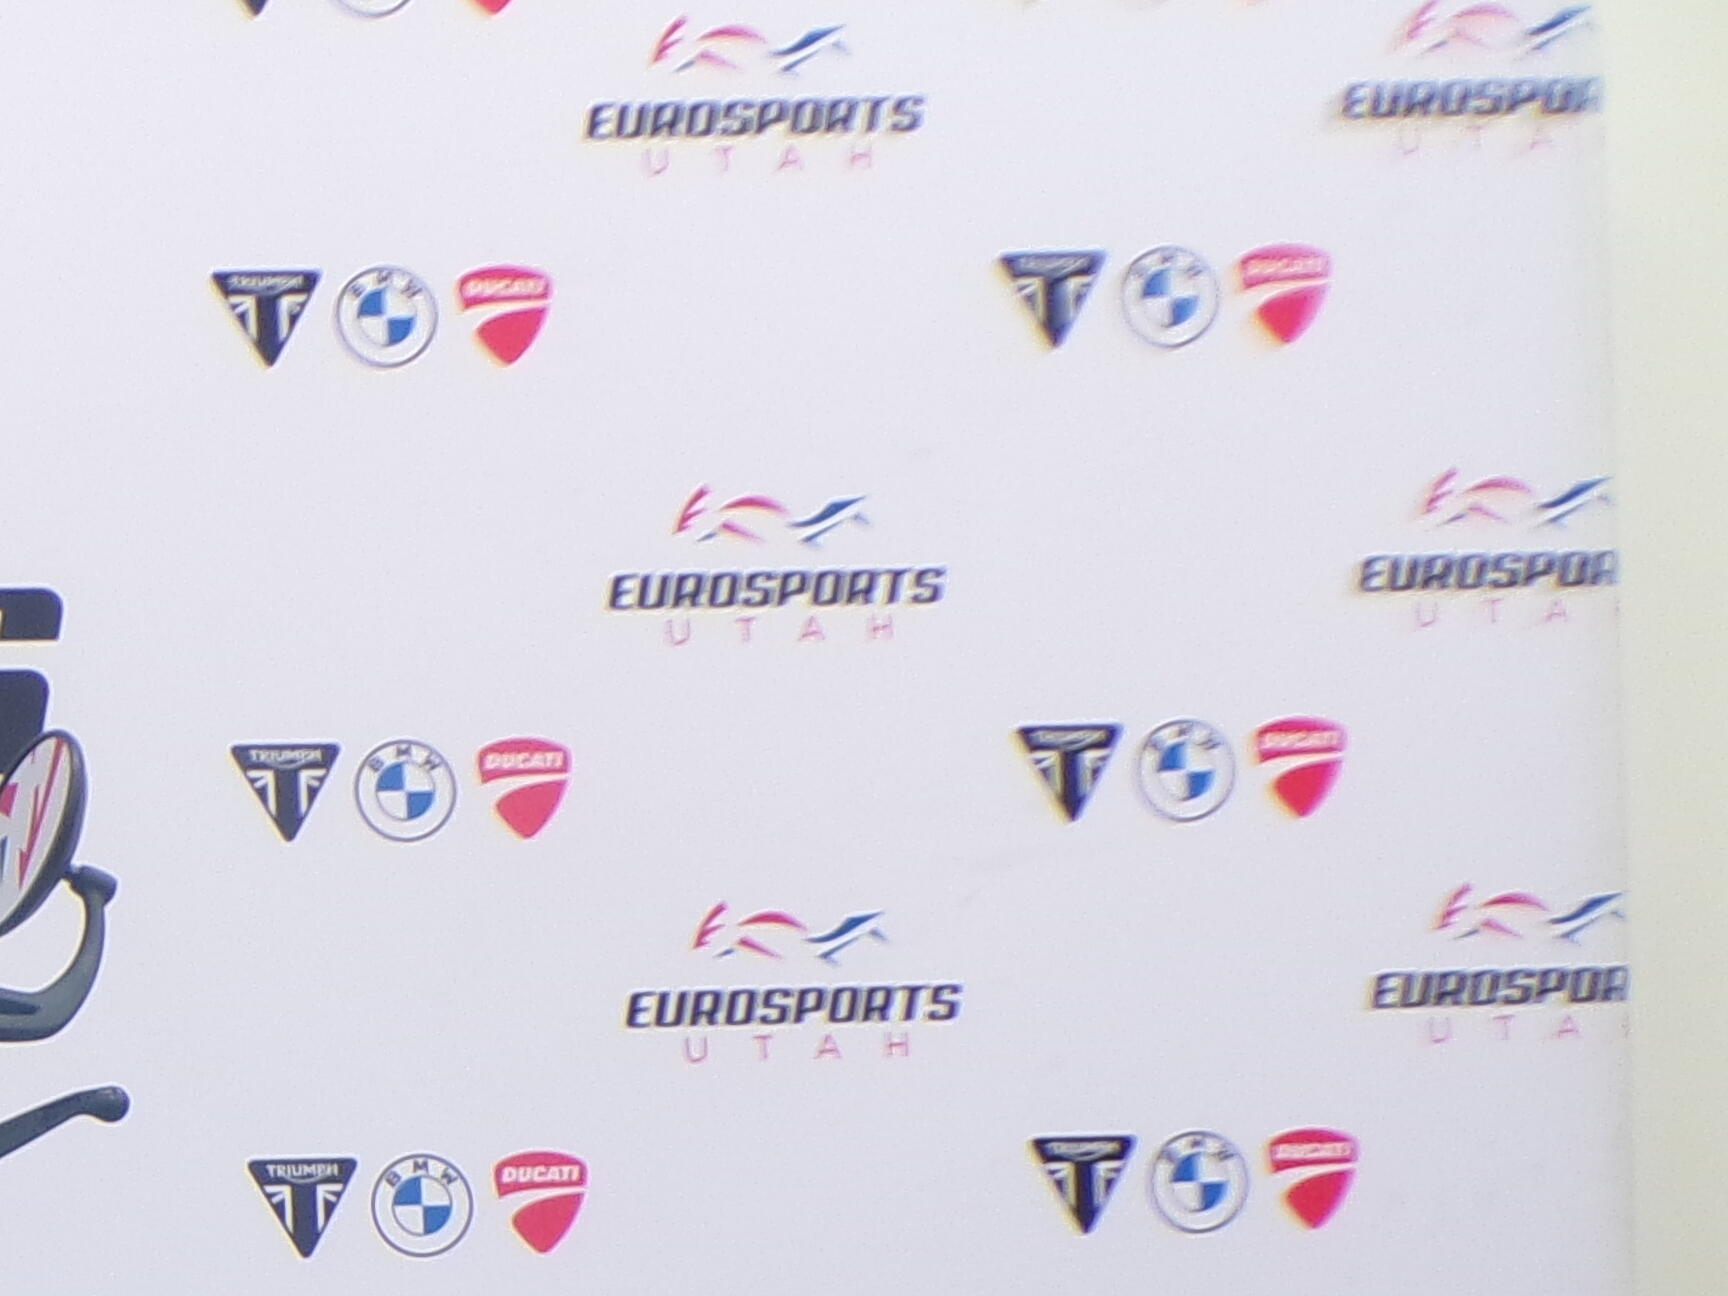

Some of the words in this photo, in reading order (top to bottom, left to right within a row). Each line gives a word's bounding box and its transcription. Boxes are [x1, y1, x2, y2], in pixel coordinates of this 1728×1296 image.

[587, 97, 925, 140] EUROSPORTS
[650, 145, 872, 176] UTAH
[1359, 552, 1618, 592] EUROSPOR
[609, 569, 942, 610] EUROSPORTS
[1414, 598, 1568, 628] UTA
[668, 616, 895, 647] UTAH
[485, 751, 564, 771] DUCATI
[1372, 967, 1627, 1009] EUROSPOR
[626, 985, 958, 1028] EUROSPORTS
[1425, 1014, 1580, 1045] UTA
[685, 1034, 911, 1064] UTAH
[386, 1160, 455, 1188] BMW
[501, 1164, 580, 1185] DUCATI
